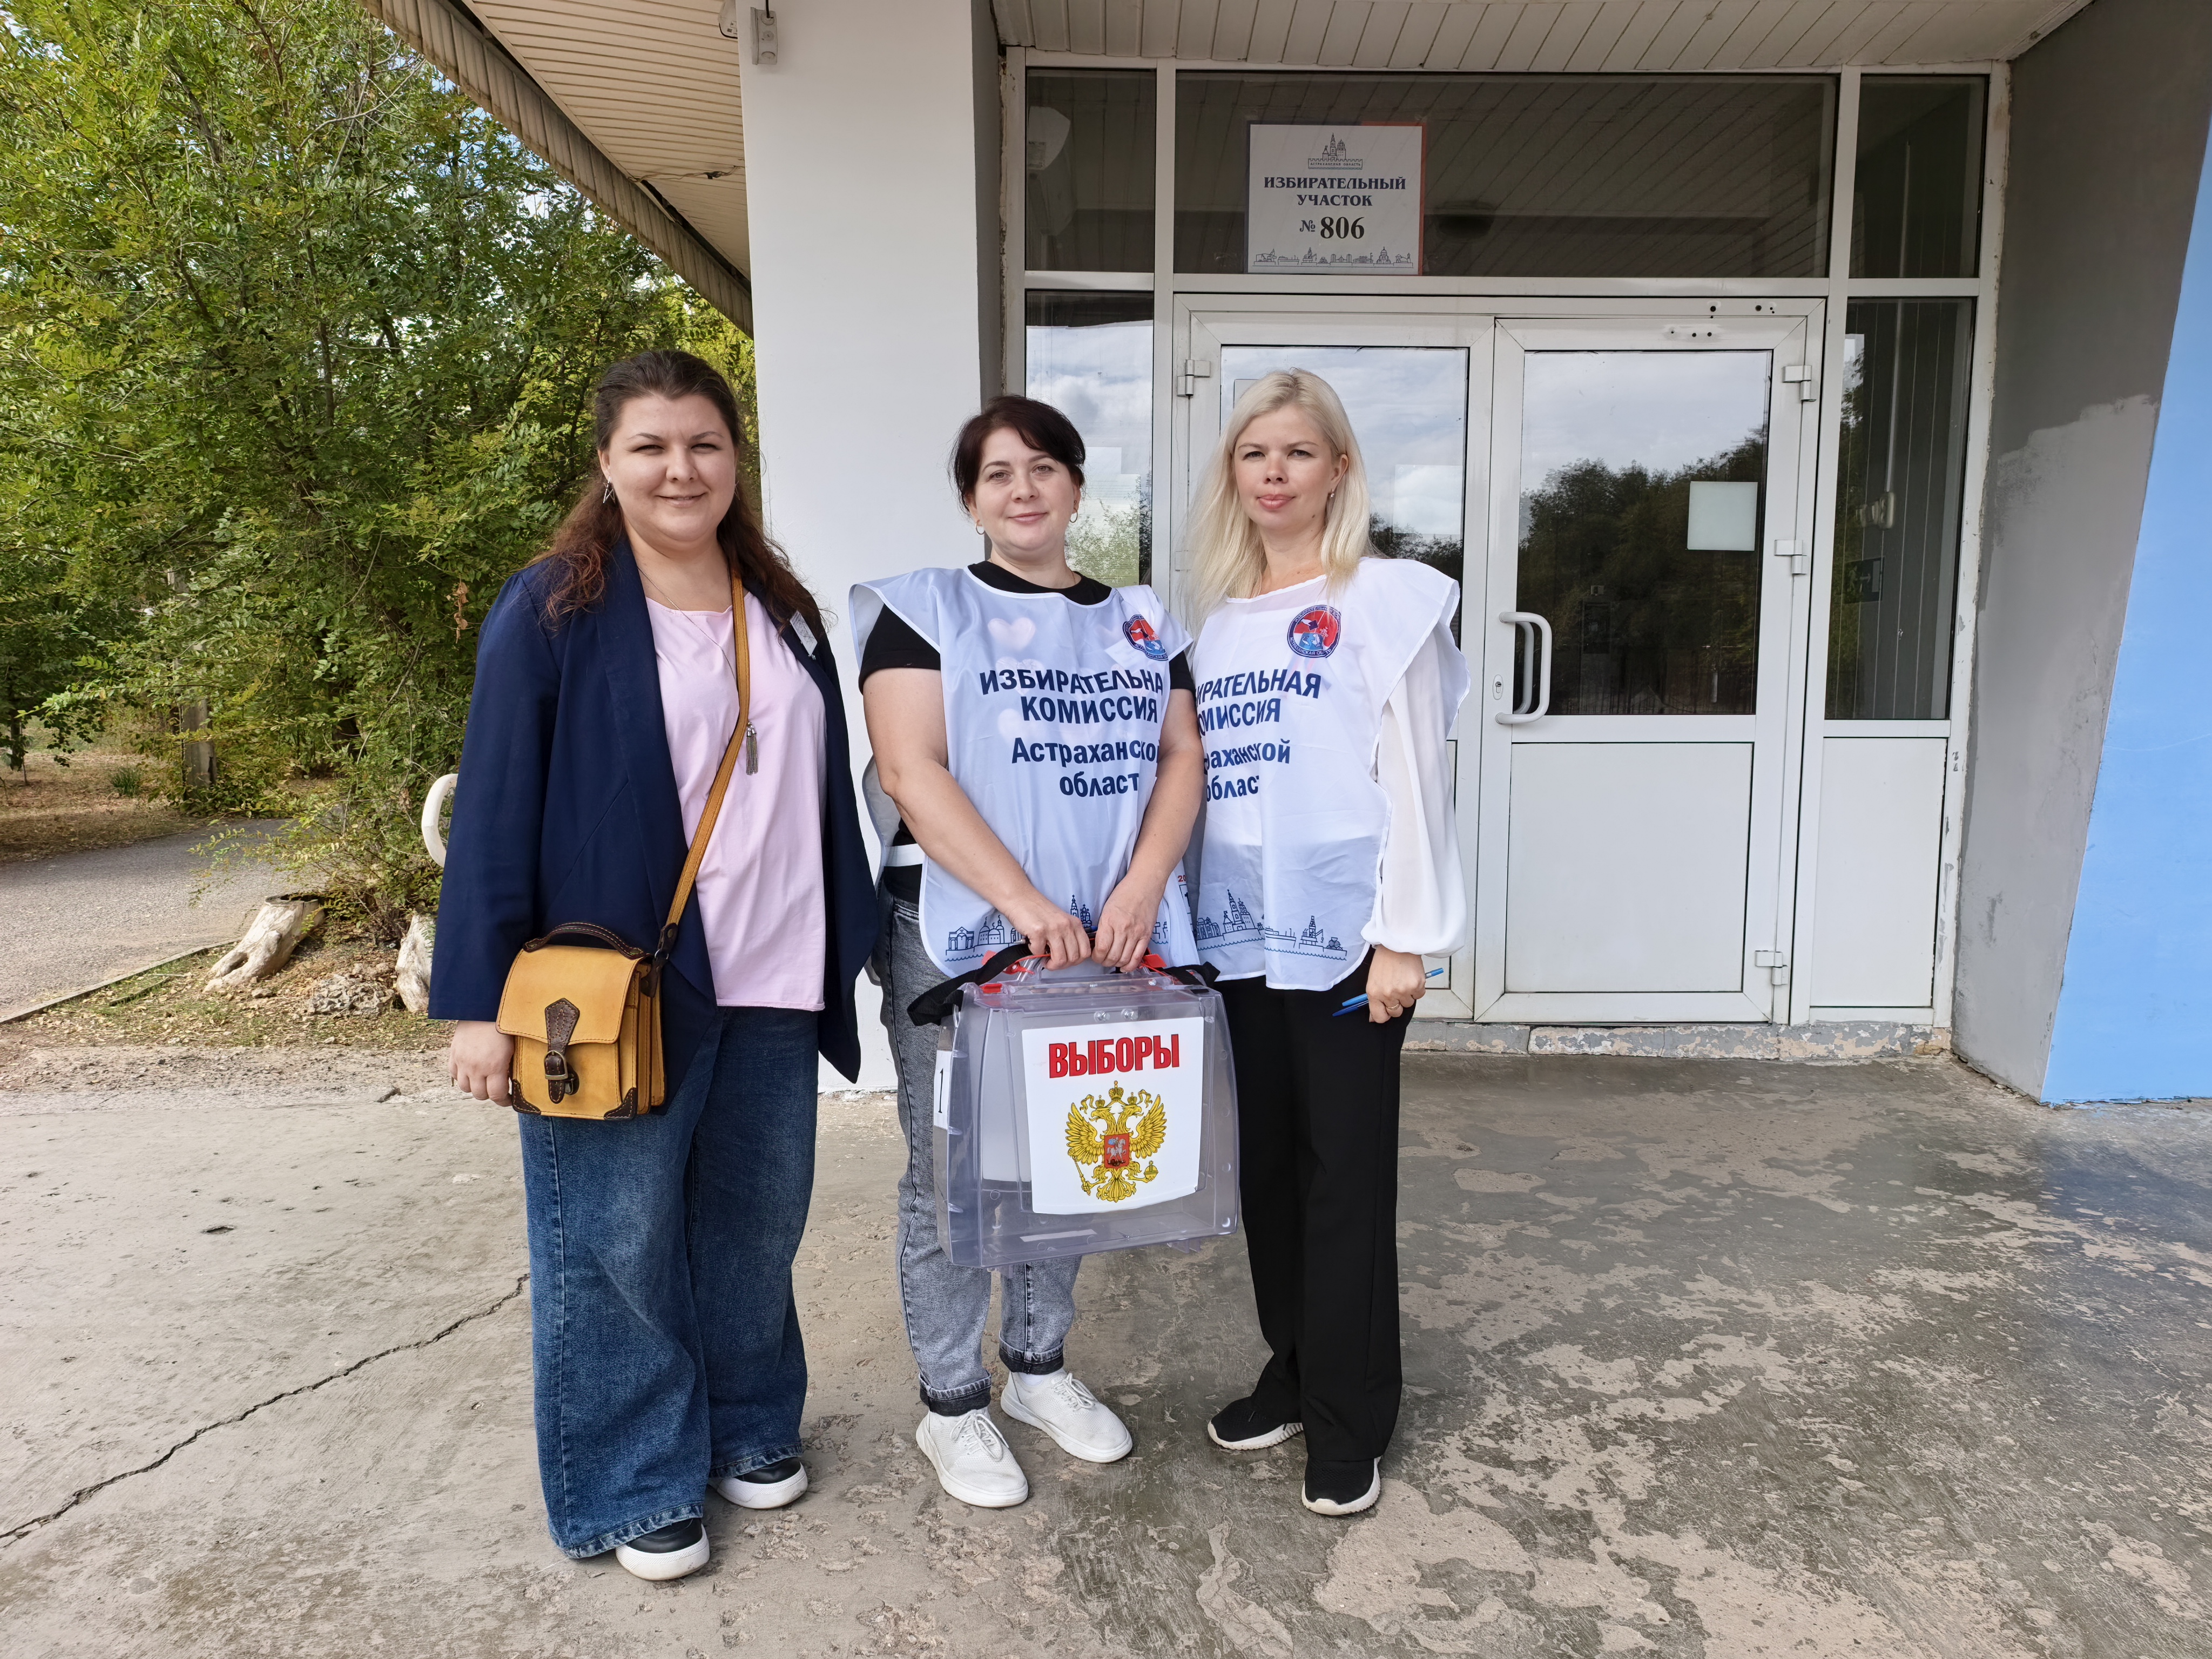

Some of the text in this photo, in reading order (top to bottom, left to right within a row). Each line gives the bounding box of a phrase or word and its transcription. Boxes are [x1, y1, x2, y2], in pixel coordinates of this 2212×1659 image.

[1264, 177, 1406, 190] ИЗБИРАТЕЛЬНЫЙ
[1297, 194, 1373, 206] УЧАСТОК
[1299, 217, 1365, 239] № 806
[979, 669, 1163, 696] ИЗБИРАТЕЛЬНА
[1195, 669, 1321, 706] ИРАТЕЛЬНАЯ
[1021, 696, 1158, 724] КОМИССИЯ
[1197, 698, 1282, 737] ОМИССИЯ
[1204, 738, 1291, 775] раханской
[1060, 771, 1139, 798] област
[1206, 775, 1259, 802] облас
[1048, 1033, 1180, 1078] ВЫБОРЫ
[938, 1068, 943, 1114] 1
